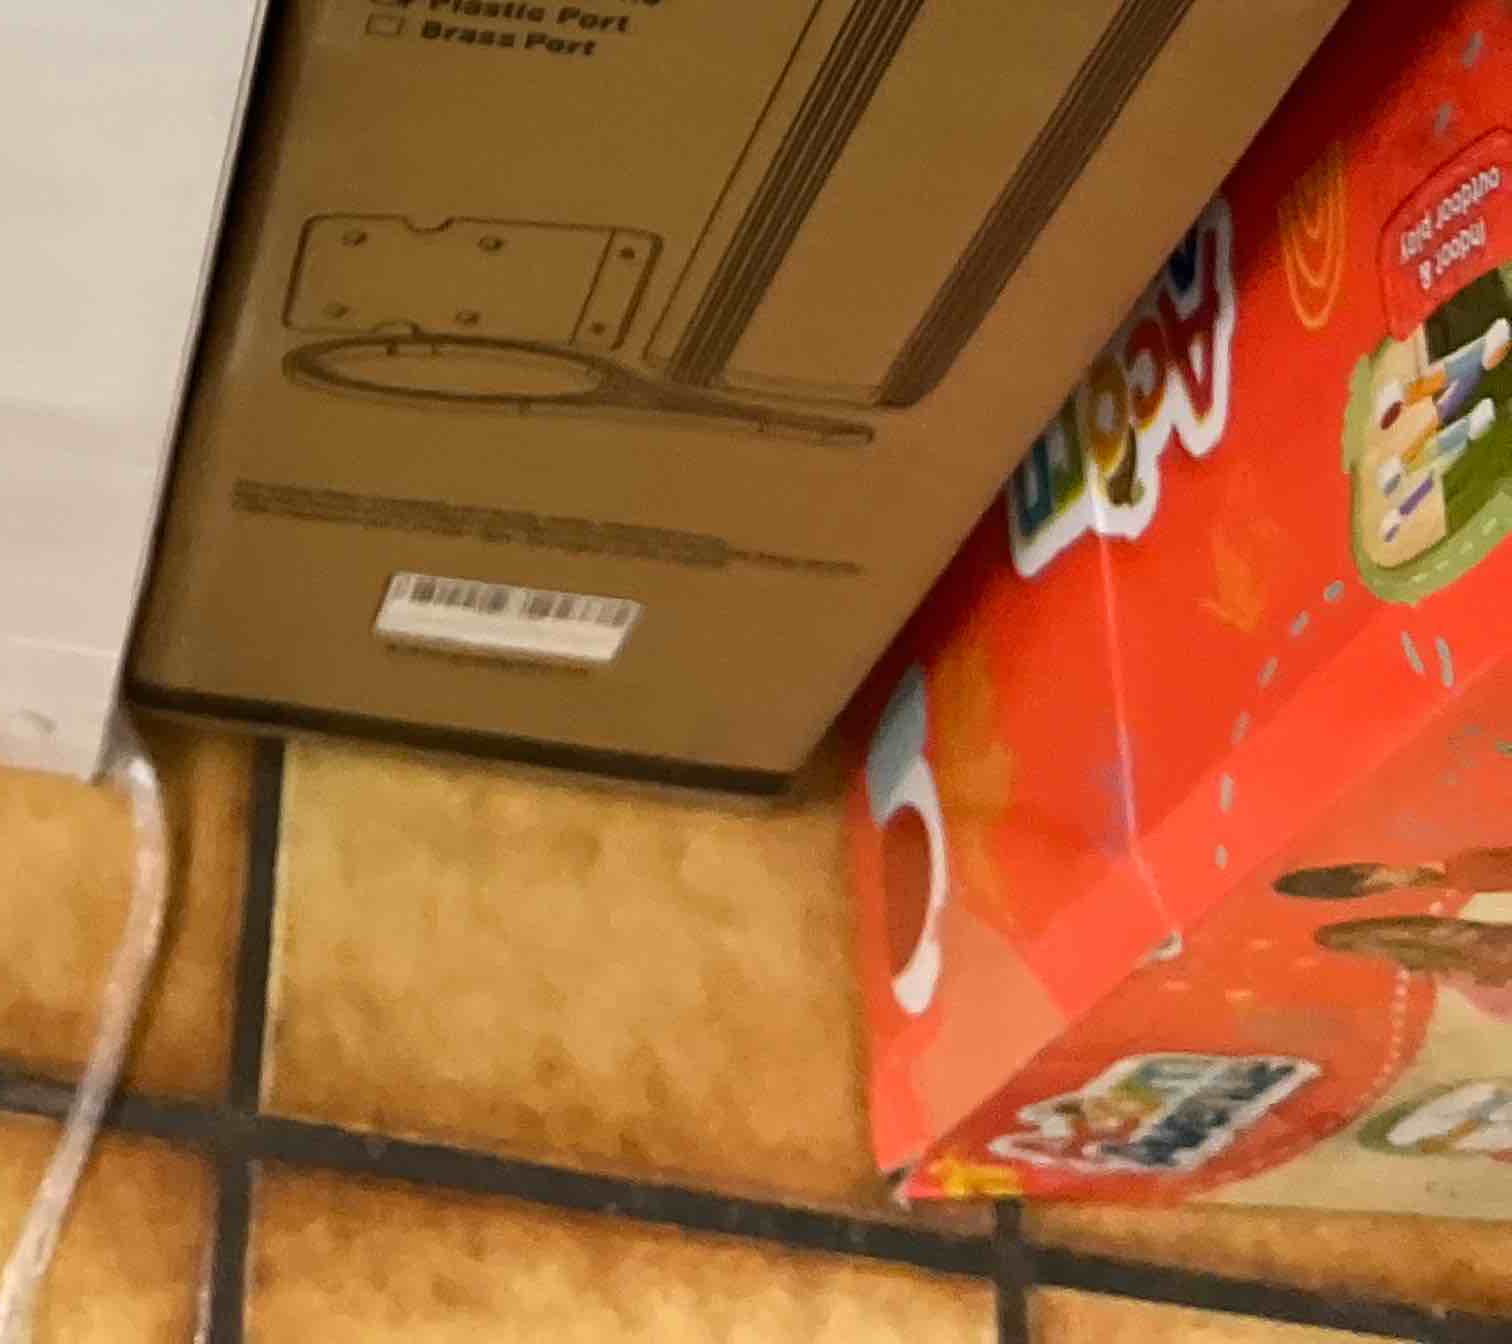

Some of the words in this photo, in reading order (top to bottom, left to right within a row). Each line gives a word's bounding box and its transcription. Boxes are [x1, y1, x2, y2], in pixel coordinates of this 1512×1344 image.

[420, 19, 515, 49] Brass
[524, 32, 598, 57] Port
[556, 5, 632, 33] Port
[1435, 165, 1502, 230] outdoor
